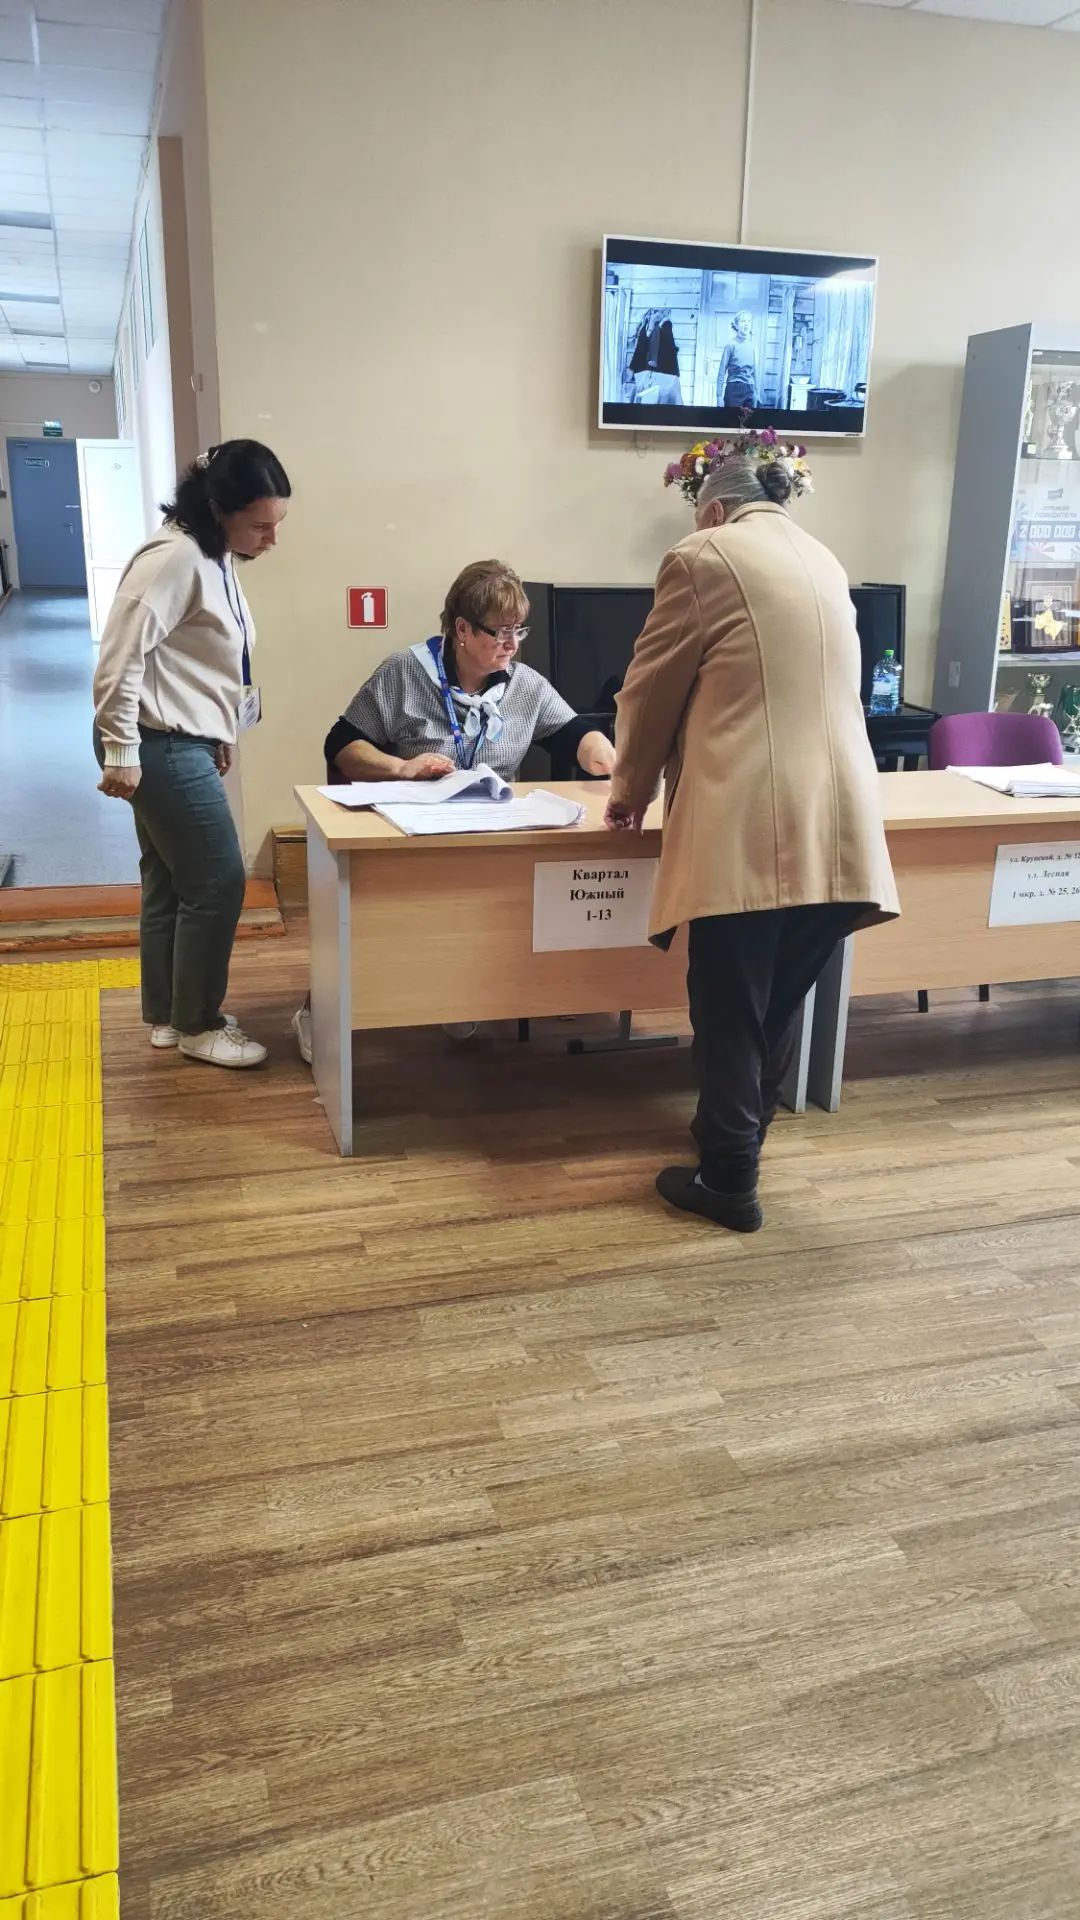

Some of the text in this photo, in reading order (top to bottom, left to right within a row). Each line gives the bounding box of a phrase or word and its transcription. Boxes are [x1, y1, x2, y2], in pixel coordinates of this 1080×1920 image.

[573, 869, 629, 882] Квартал
[570, 887, 625, 901] Южный
[586, 908, 612, 921] 1-13
